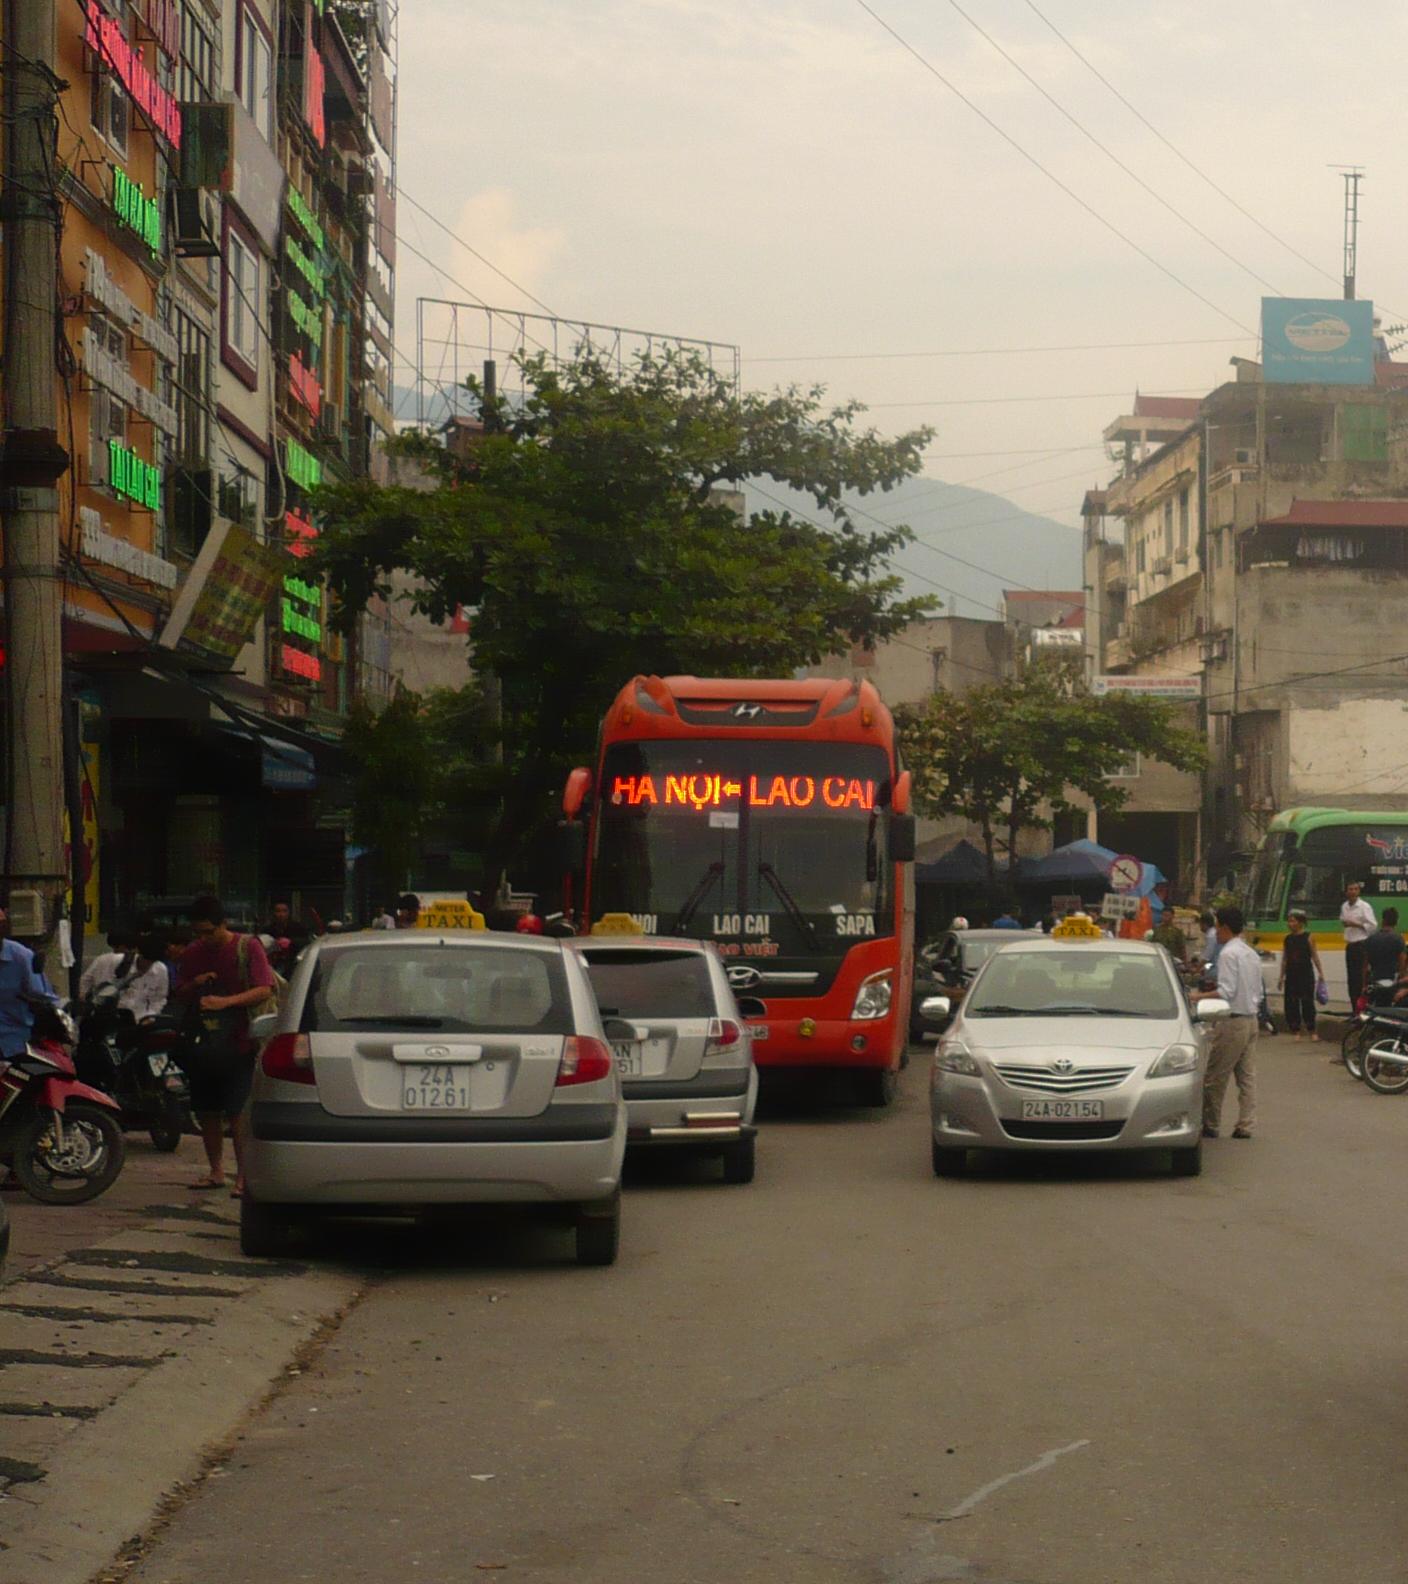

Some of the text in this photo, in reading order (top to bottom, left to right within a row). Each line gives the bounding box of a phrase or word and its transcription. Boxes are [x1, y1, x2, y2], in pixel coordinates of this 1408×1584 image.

[749, 775, 815, 807] LAO
[822, 776, 874, 809] CAI
[424, 914, 474, 929] TAXI
[714, 914, 770, 935] LAO CAI
[836, 914, 876, 936] SAPA
[1060, 928, 1094, 936] TAXI
[420, 1065, 455, 1086] 24A
